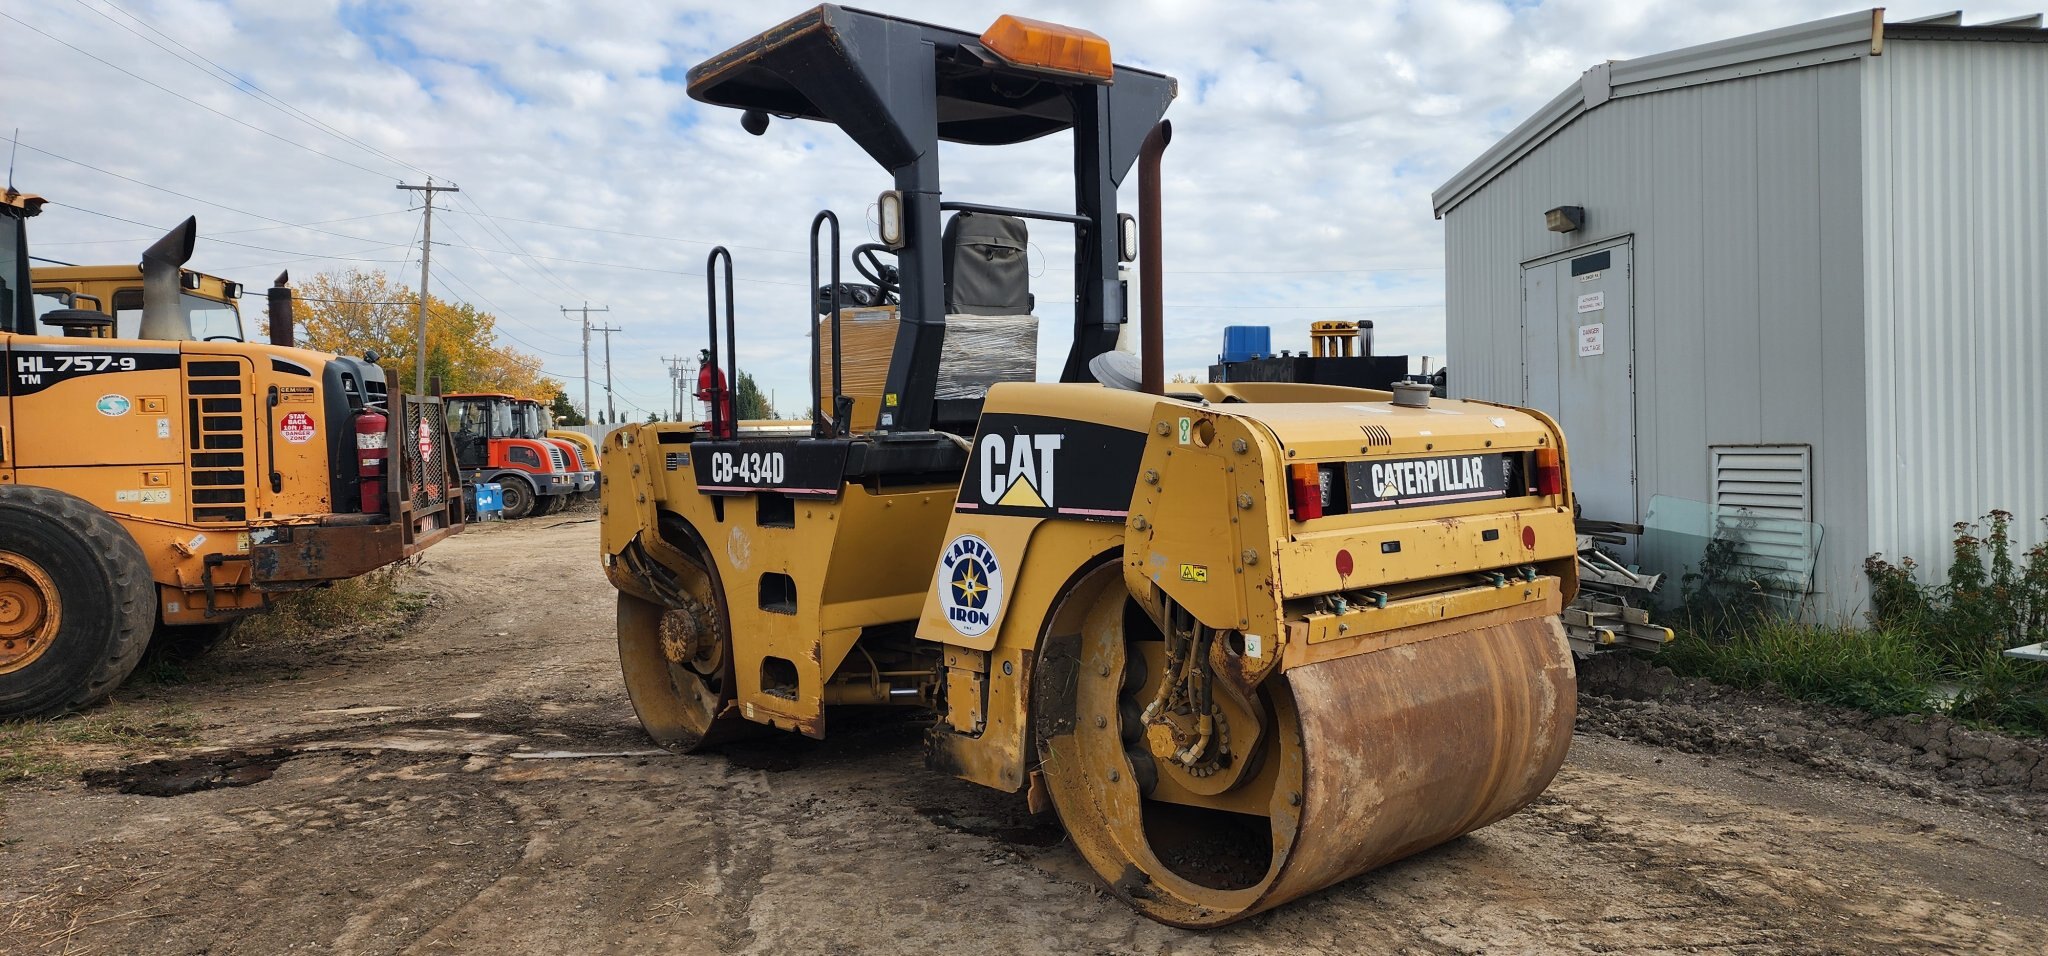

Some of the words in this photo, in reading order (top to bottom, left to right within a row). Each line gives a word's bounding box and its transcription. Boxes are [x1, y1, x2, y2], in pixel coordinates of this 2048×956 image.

[17, 355, 136, 372] HL757-9
[18, 374, 41, 385] TM
[712, 452, 784, 484] CB-434D
[980, 433, 1061, 508] CAT
[1371, 456, 1484, 498] CATERPILLAR
[943, 539, 998, 574] EARTH
[949, 606, 989, 626] IRON
